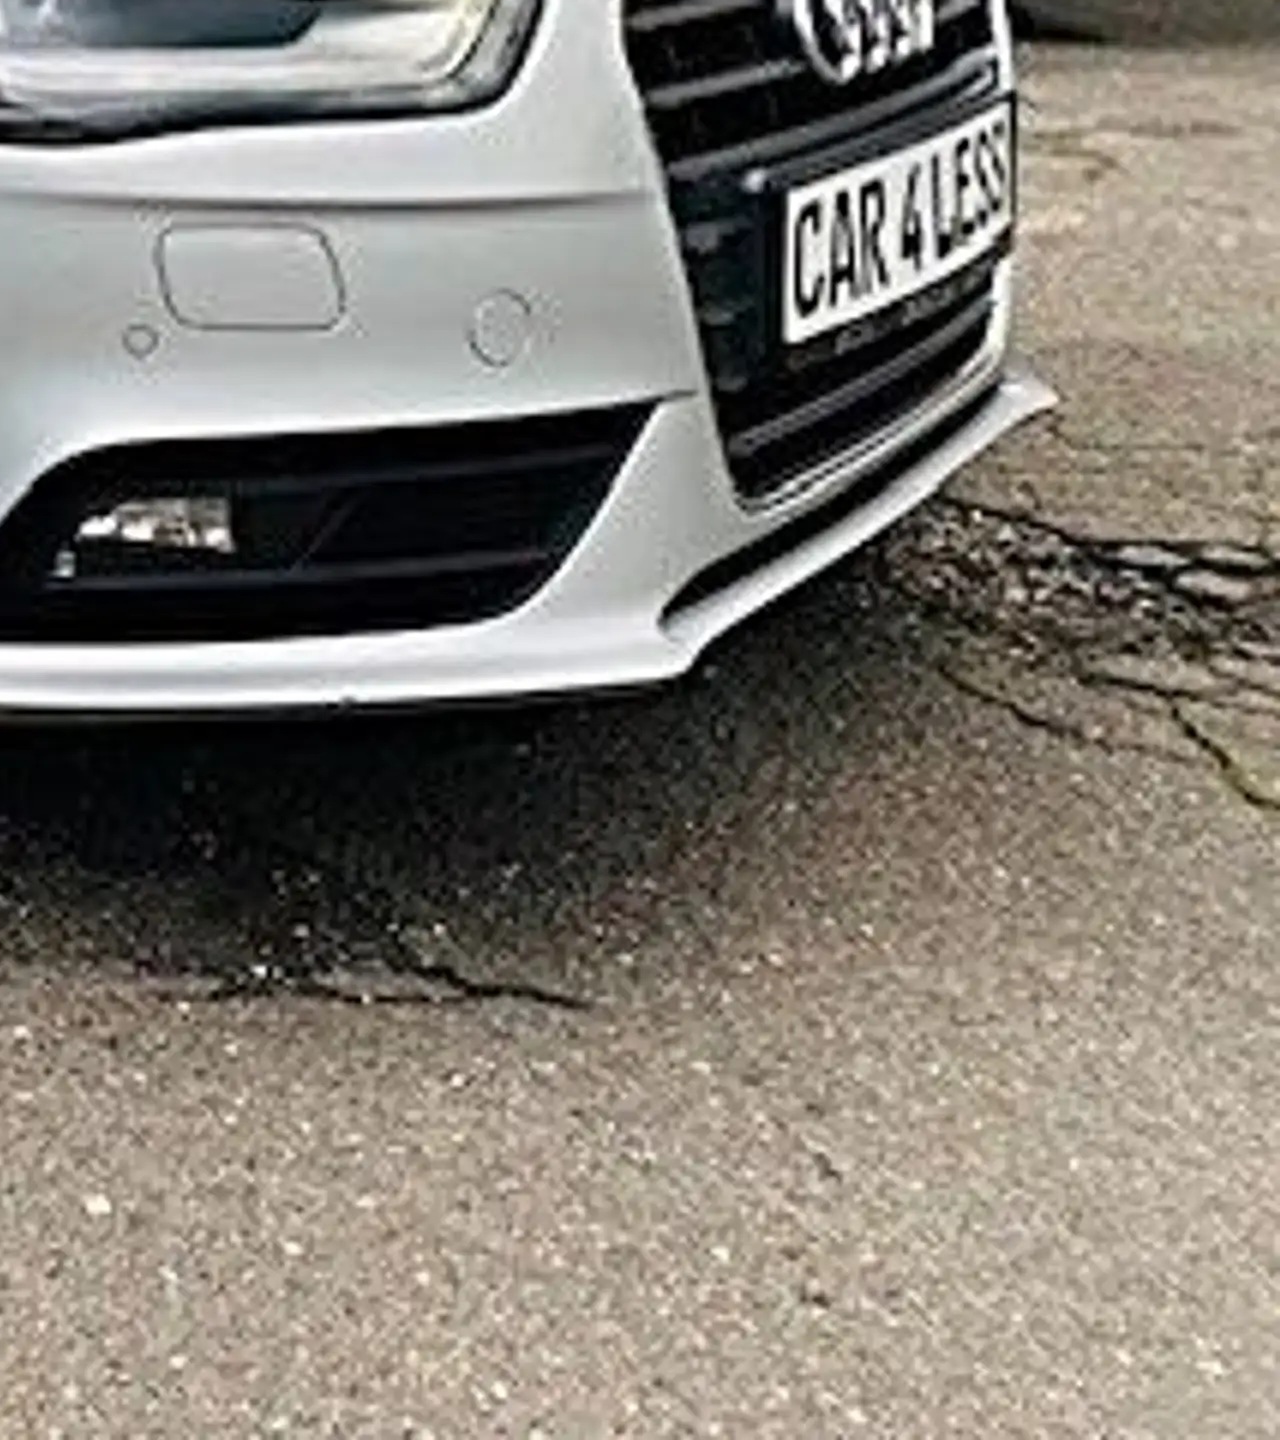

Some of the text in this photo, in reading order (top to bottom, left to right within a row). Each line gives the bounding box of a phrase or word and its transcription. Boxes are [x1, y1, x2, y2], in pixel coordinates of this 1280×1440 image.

[794, 120, 1008, 318] CAR 4 LESS
